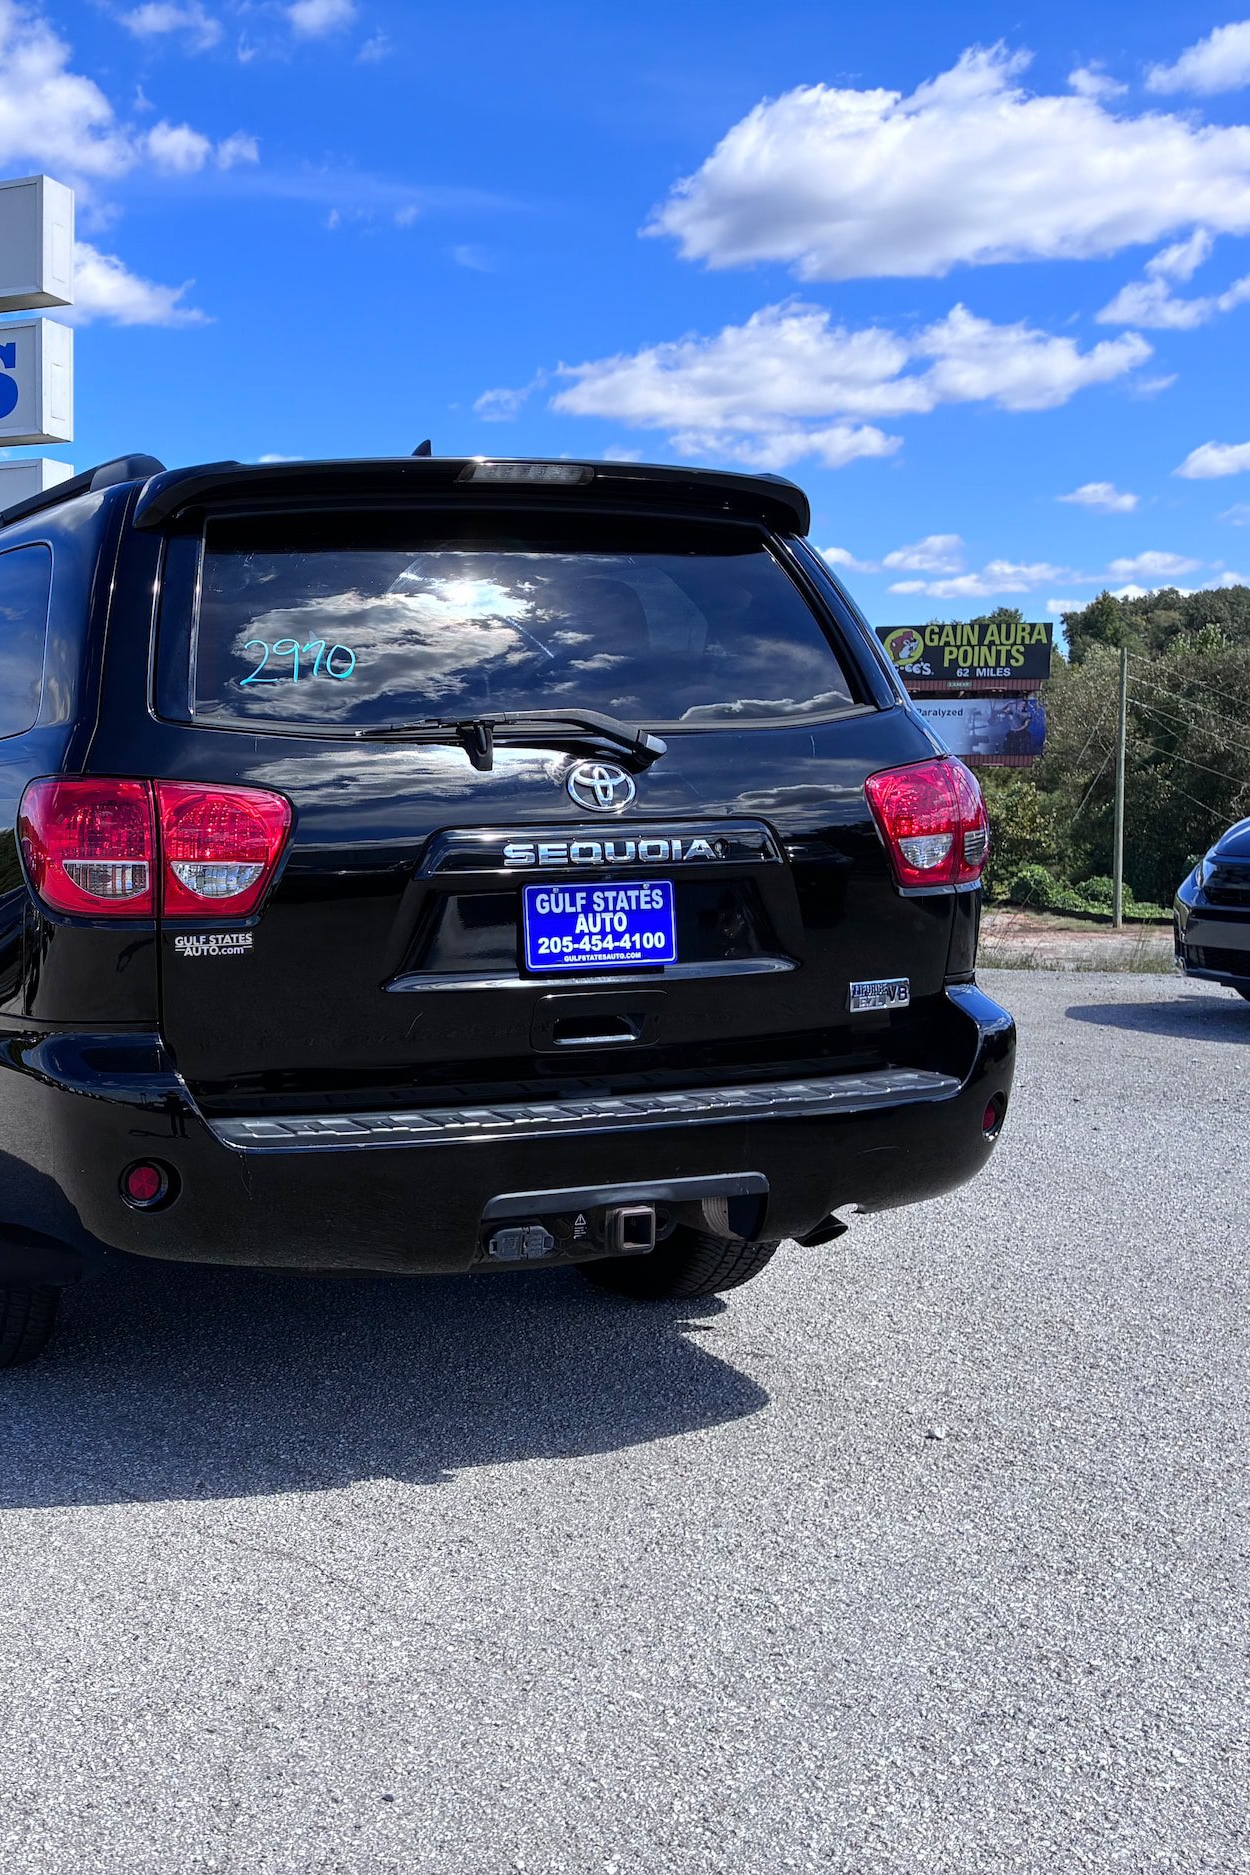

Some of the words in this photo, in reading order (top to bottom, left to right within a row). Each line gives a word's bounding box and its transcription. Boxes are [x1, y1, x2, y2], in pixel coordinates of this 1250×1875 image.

[924, 624, 979, 647] GAIN
[983, 623, 1048, 645] AURA
[943, 645, 1025, 668] POINTS
[956, 668, 969, 677] 62
[976, 667, 1011, 677] MILES
[502, 838, 717, 866] SEQUOIA
[535, 891, 587, 914] GULF
[592, 888, 664, 911] STATES
[575, 911, 627, 934] AUTO
[175, 935, 207, 946] GULF
[209, 933, 253, 945] STATES
[538, 931, 665, 954] 205-454-4100
[183, 946, 244, 957] AUTO.com
[563, 952, 641, 963] GULFSTATESAUTO.COM
[888, 984, 909, 1004] V8
